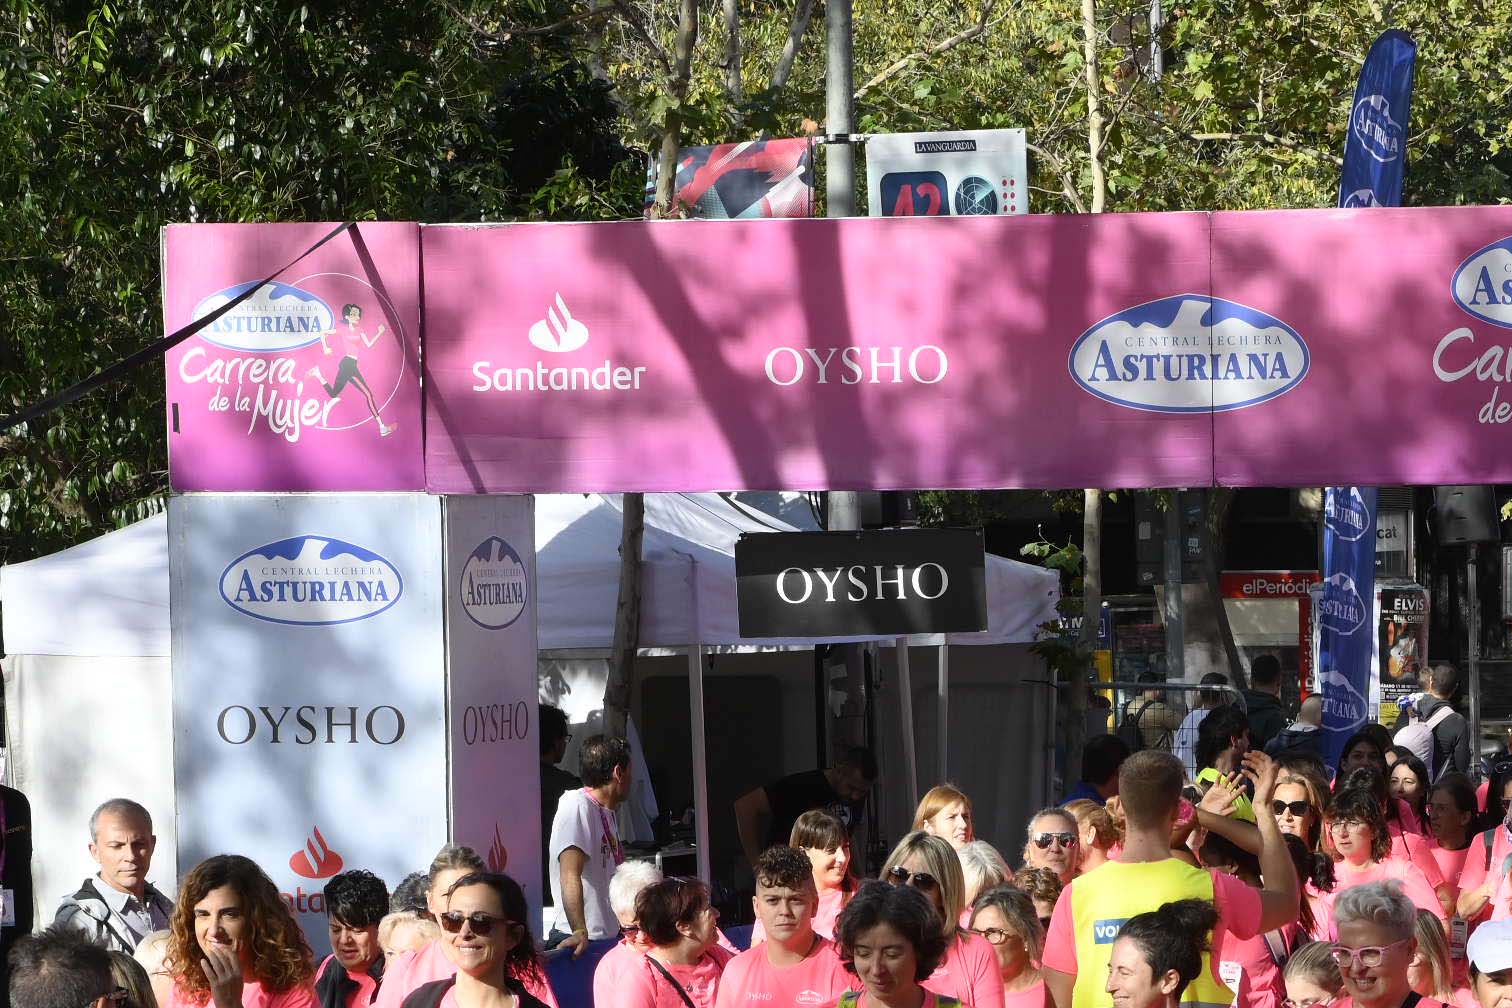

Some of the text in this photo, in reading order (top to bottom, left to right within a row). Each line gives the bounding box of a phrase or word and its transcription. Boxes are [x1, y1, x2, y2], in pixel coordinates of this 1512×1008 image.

[916, 141, 975, 152] LA VANGUARDIA
[1125, 334, 1283, 347] CENTRAL LECHERA
[179, 347, 296, 384] Carrera
[473, 361, 646, 392] Santander
[765, 345, 948, 386] OYSHO
[1088, 339, 1291, 382] ASTURIANA
[208, 381, 342, 443] de la Mujer
[1479, 385, 1512, 424] de
[234, 568, 389, 604] ASTURIANA
[262, 566, 383, 576] CENTRAL LECHERA
[776, 563, 949, 604] OYSHO
[1242, 578, 1317, 595] elPeriódi
[466, 578, 524, 607] ASTURIANA
[1394, 599, 1424, 610] ELVIS
[217, 705, 405, 745] OYSHO
[464, 701, 529, 745] OYSHO
